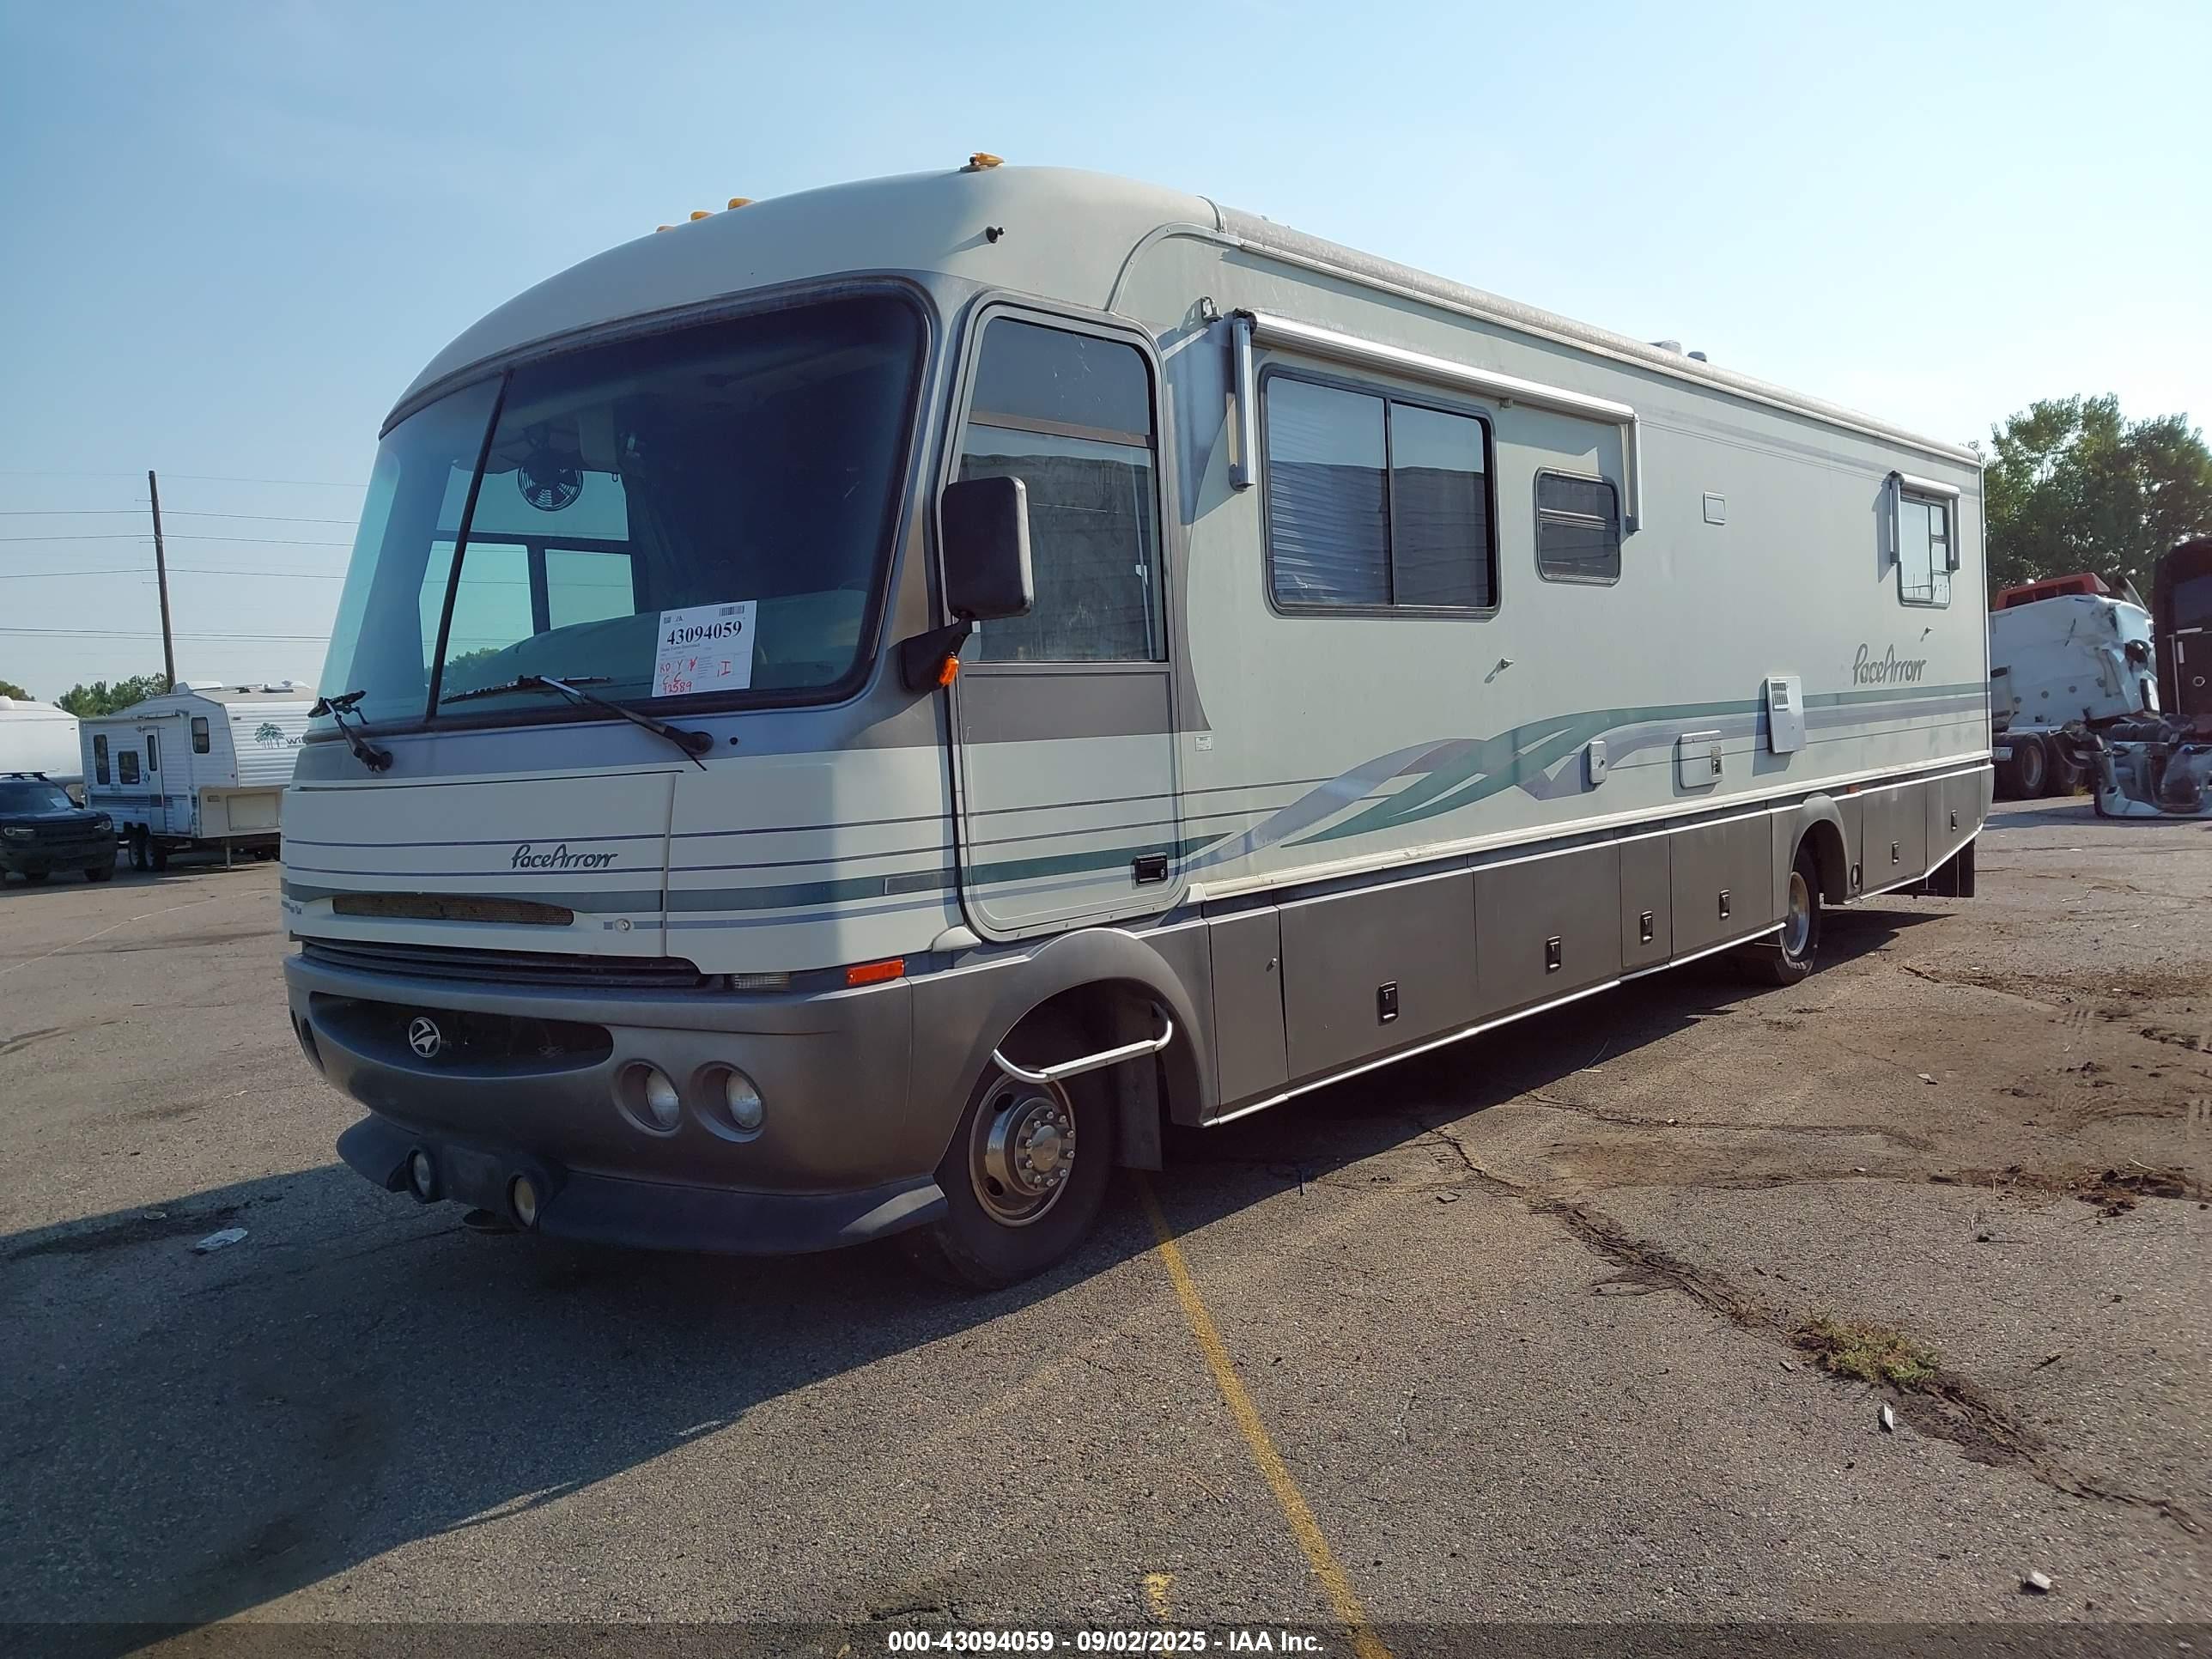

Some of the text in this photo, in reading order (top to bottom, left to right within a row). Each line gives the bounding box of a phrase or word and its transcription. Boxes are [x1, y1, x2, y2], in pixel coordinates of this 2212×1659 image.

[667, 621, 742, 645] 43094059
[1852, 643, 1927, 687] PaceArrow
[511, 843, 619, 869] PaceArrow
